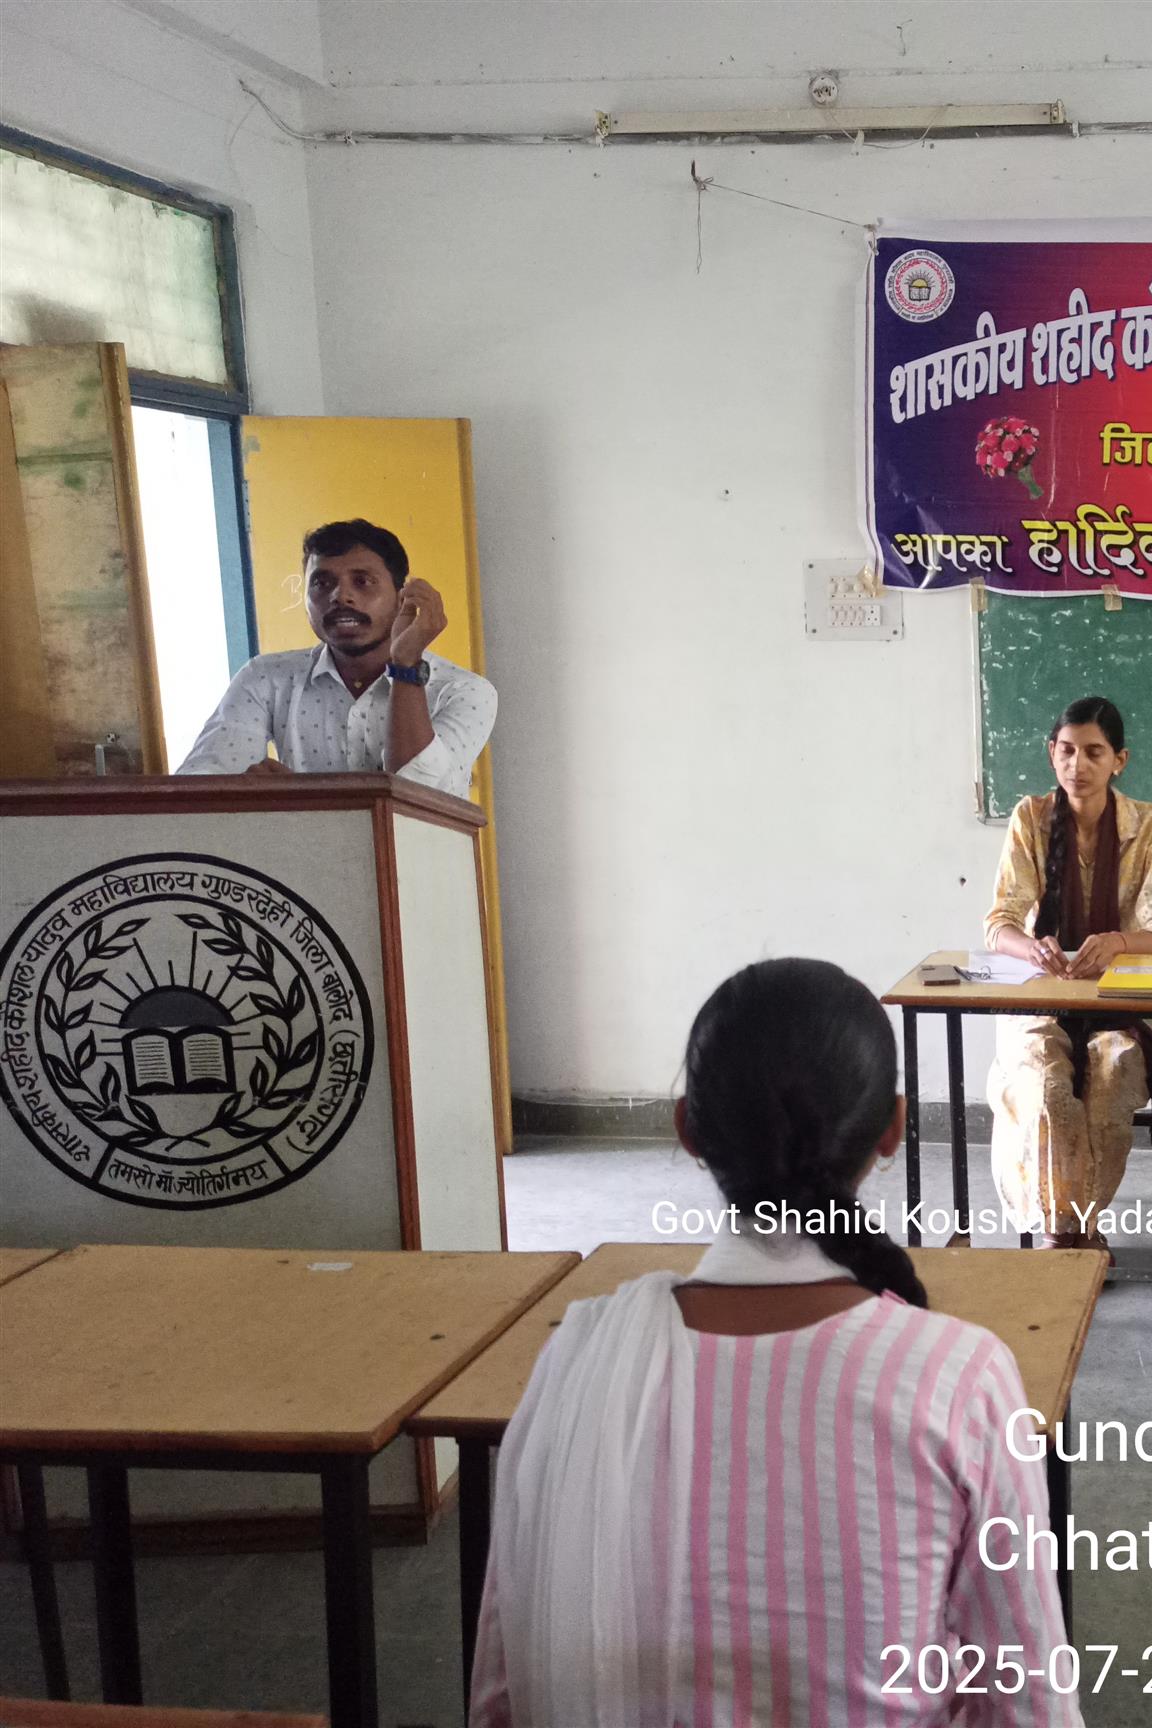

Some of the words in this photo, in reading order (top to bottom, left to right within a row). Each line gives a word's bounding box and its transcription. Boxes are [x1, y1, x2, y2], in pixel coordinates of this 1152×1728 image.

[889, 311, 1027, 423] शासकीय
[1031, 288, 1116, 386] शहीद
[891, 532, 1015, 573] आपका
[21, 908, 73, 963] यादव
[68, 871, 198, 916] महाविद्यालय
[201, 873, 294, 928] गुण्डरदेही
[289, 915, 335, 974] जिला
[108, 1158, 156, 1189] तमसो
